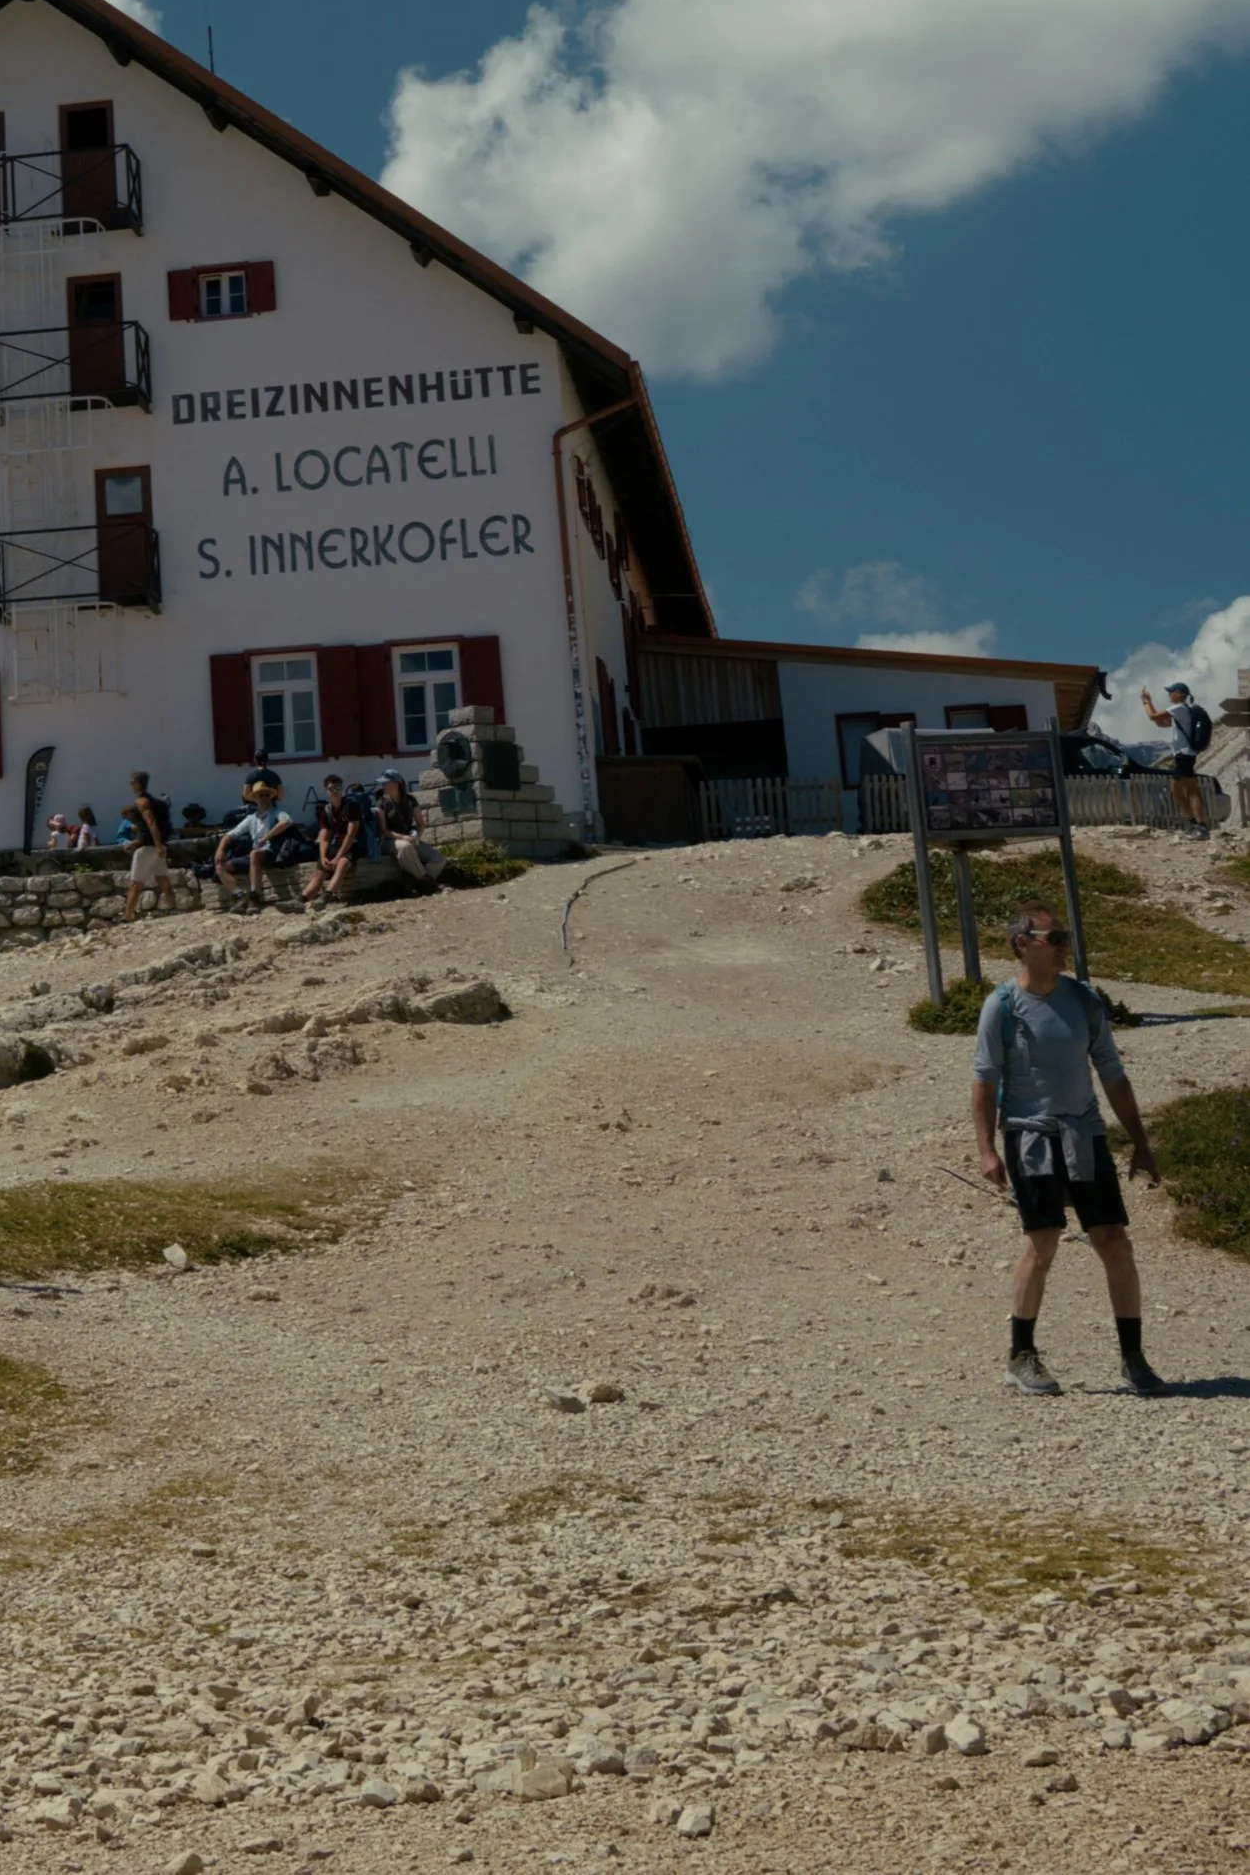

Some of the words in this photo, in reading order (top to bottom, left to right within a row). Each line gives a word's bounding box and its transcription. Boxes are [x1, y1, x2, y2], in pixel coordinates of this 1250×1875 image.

[172, 362, 541, 425] DREIZINNENHÜTTE
[222, 456, 259, 496] A.
[275, 434, 498, 493] LOCATELLI
[198, 537, 233, 580] S.
[249, 514, 535, 575] INNERKOFLER
